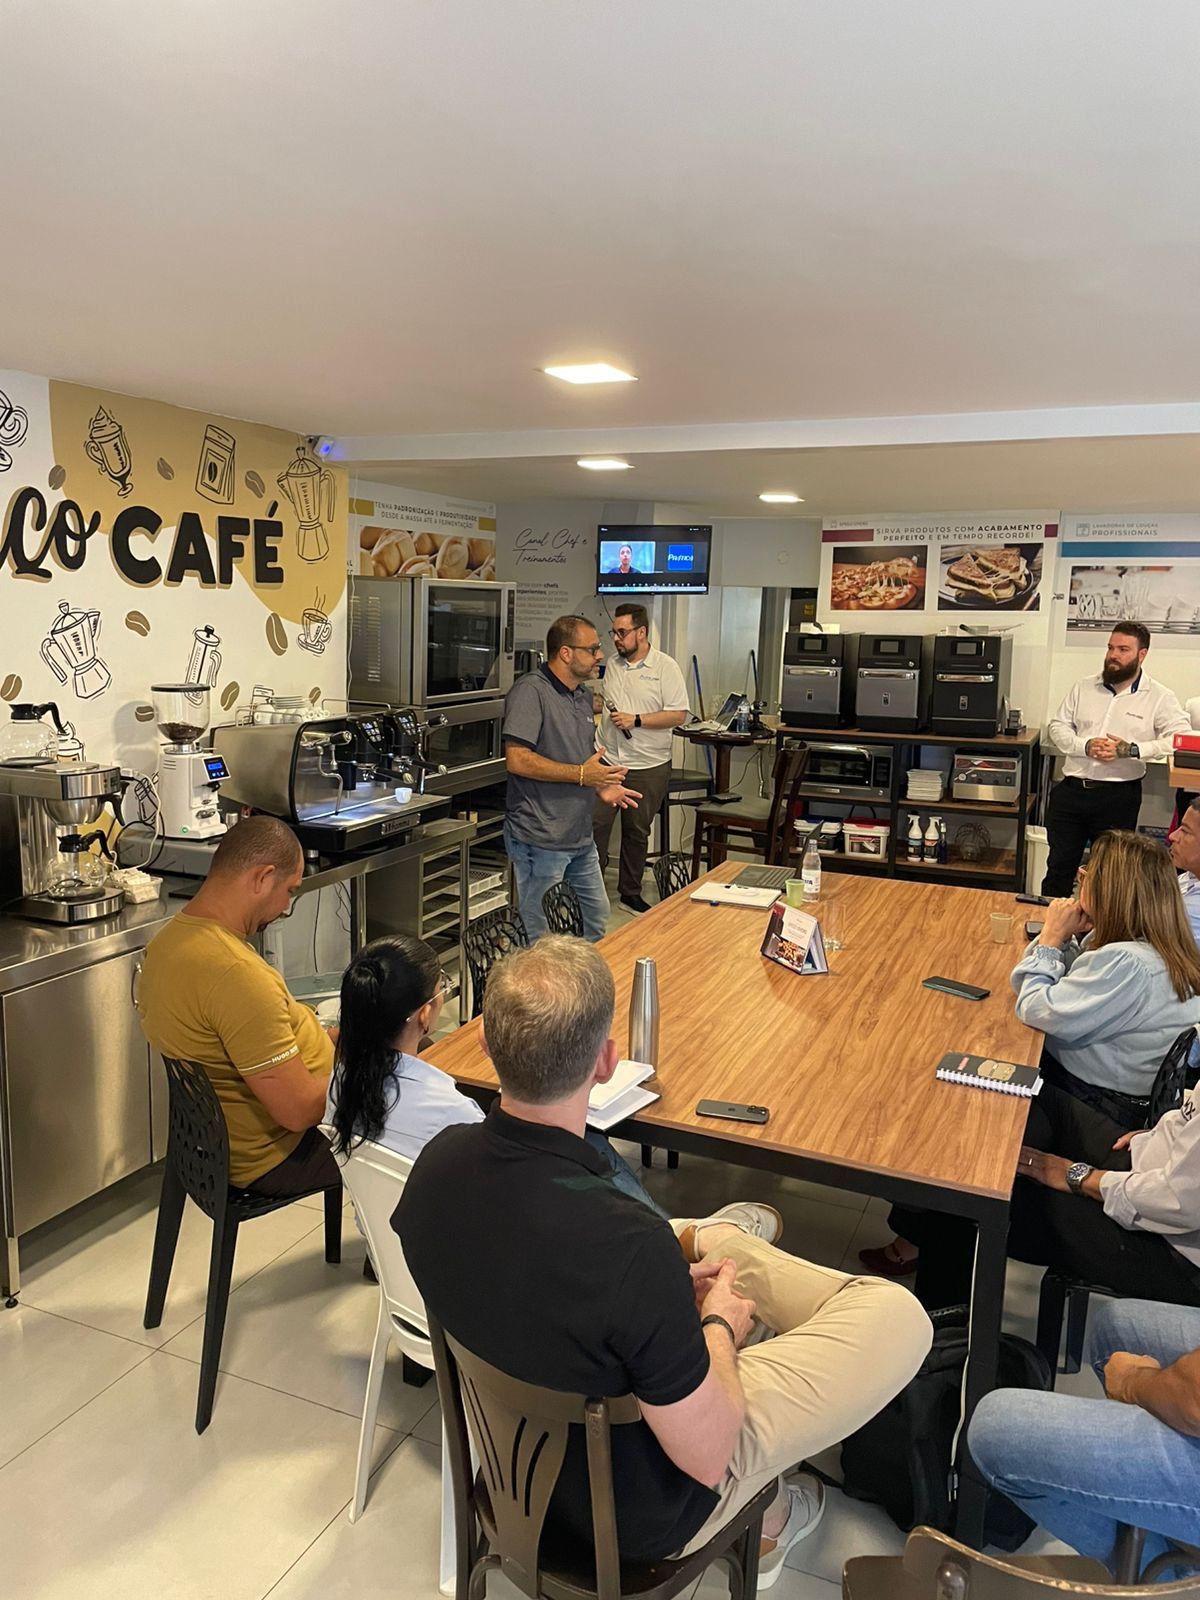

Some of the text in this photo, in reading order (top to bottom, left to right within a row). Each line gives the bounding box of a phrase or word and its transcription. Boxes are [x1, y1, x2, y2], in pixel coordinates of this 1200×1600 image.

[381, 511, 399, 520] DESDE
[405, 514, 422, 522] MASSA
[977, 524, 1042, 532] ACABAMENTO
[111, 500, 284, 586] CAFÉ
[552, 528, 580, 549] Chef
[271, 1050, 290, 1063] HUGO
